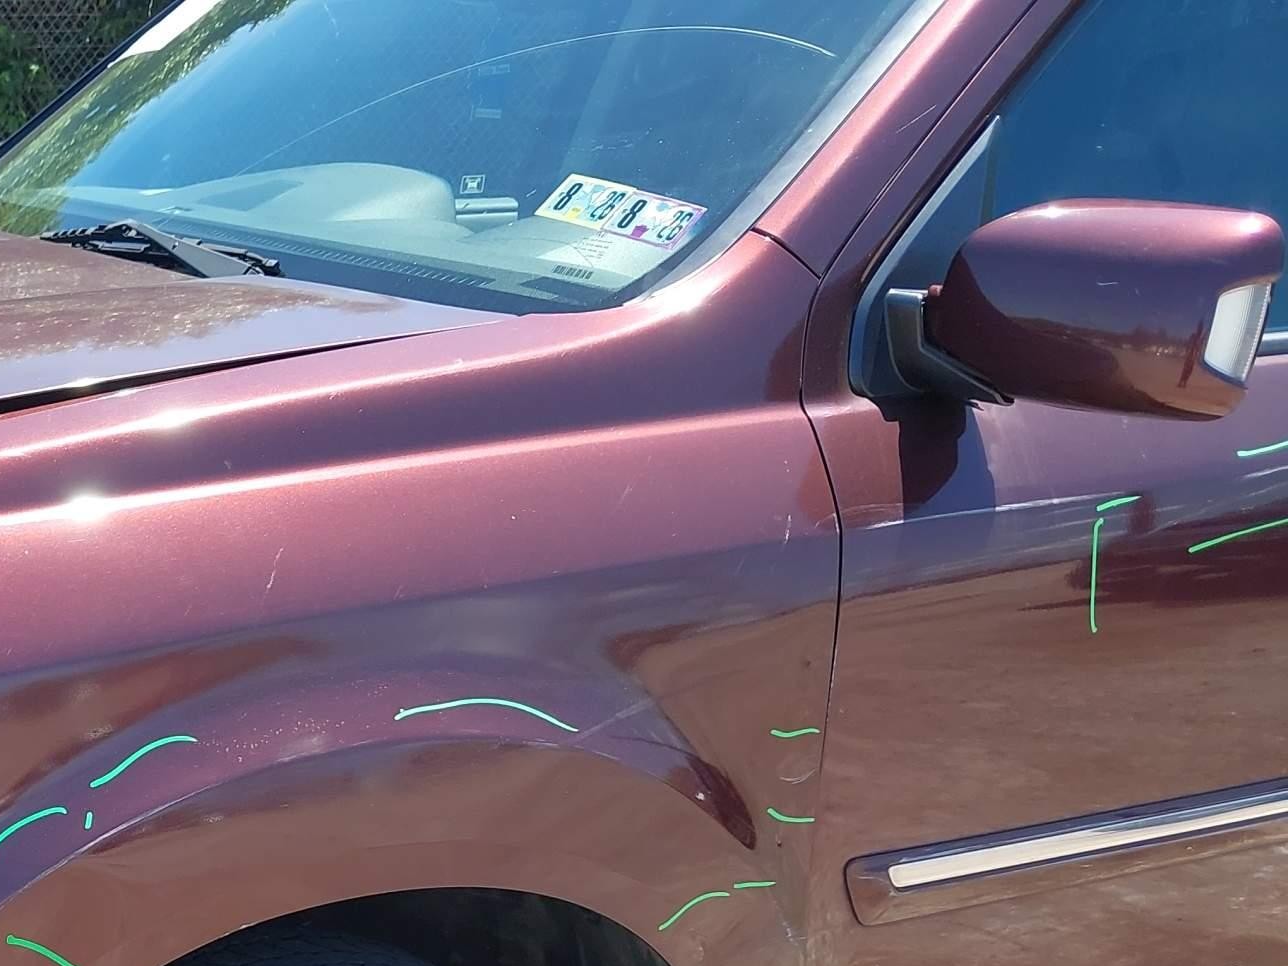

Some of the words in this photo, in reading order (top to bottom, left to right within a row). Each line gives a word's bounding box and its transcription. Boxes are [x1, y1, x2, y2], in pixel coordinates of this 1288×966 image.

[553, 183, 583, 210] 8
[617, 200, 647, 228] 8
[657, 211, 693, 240] 26
